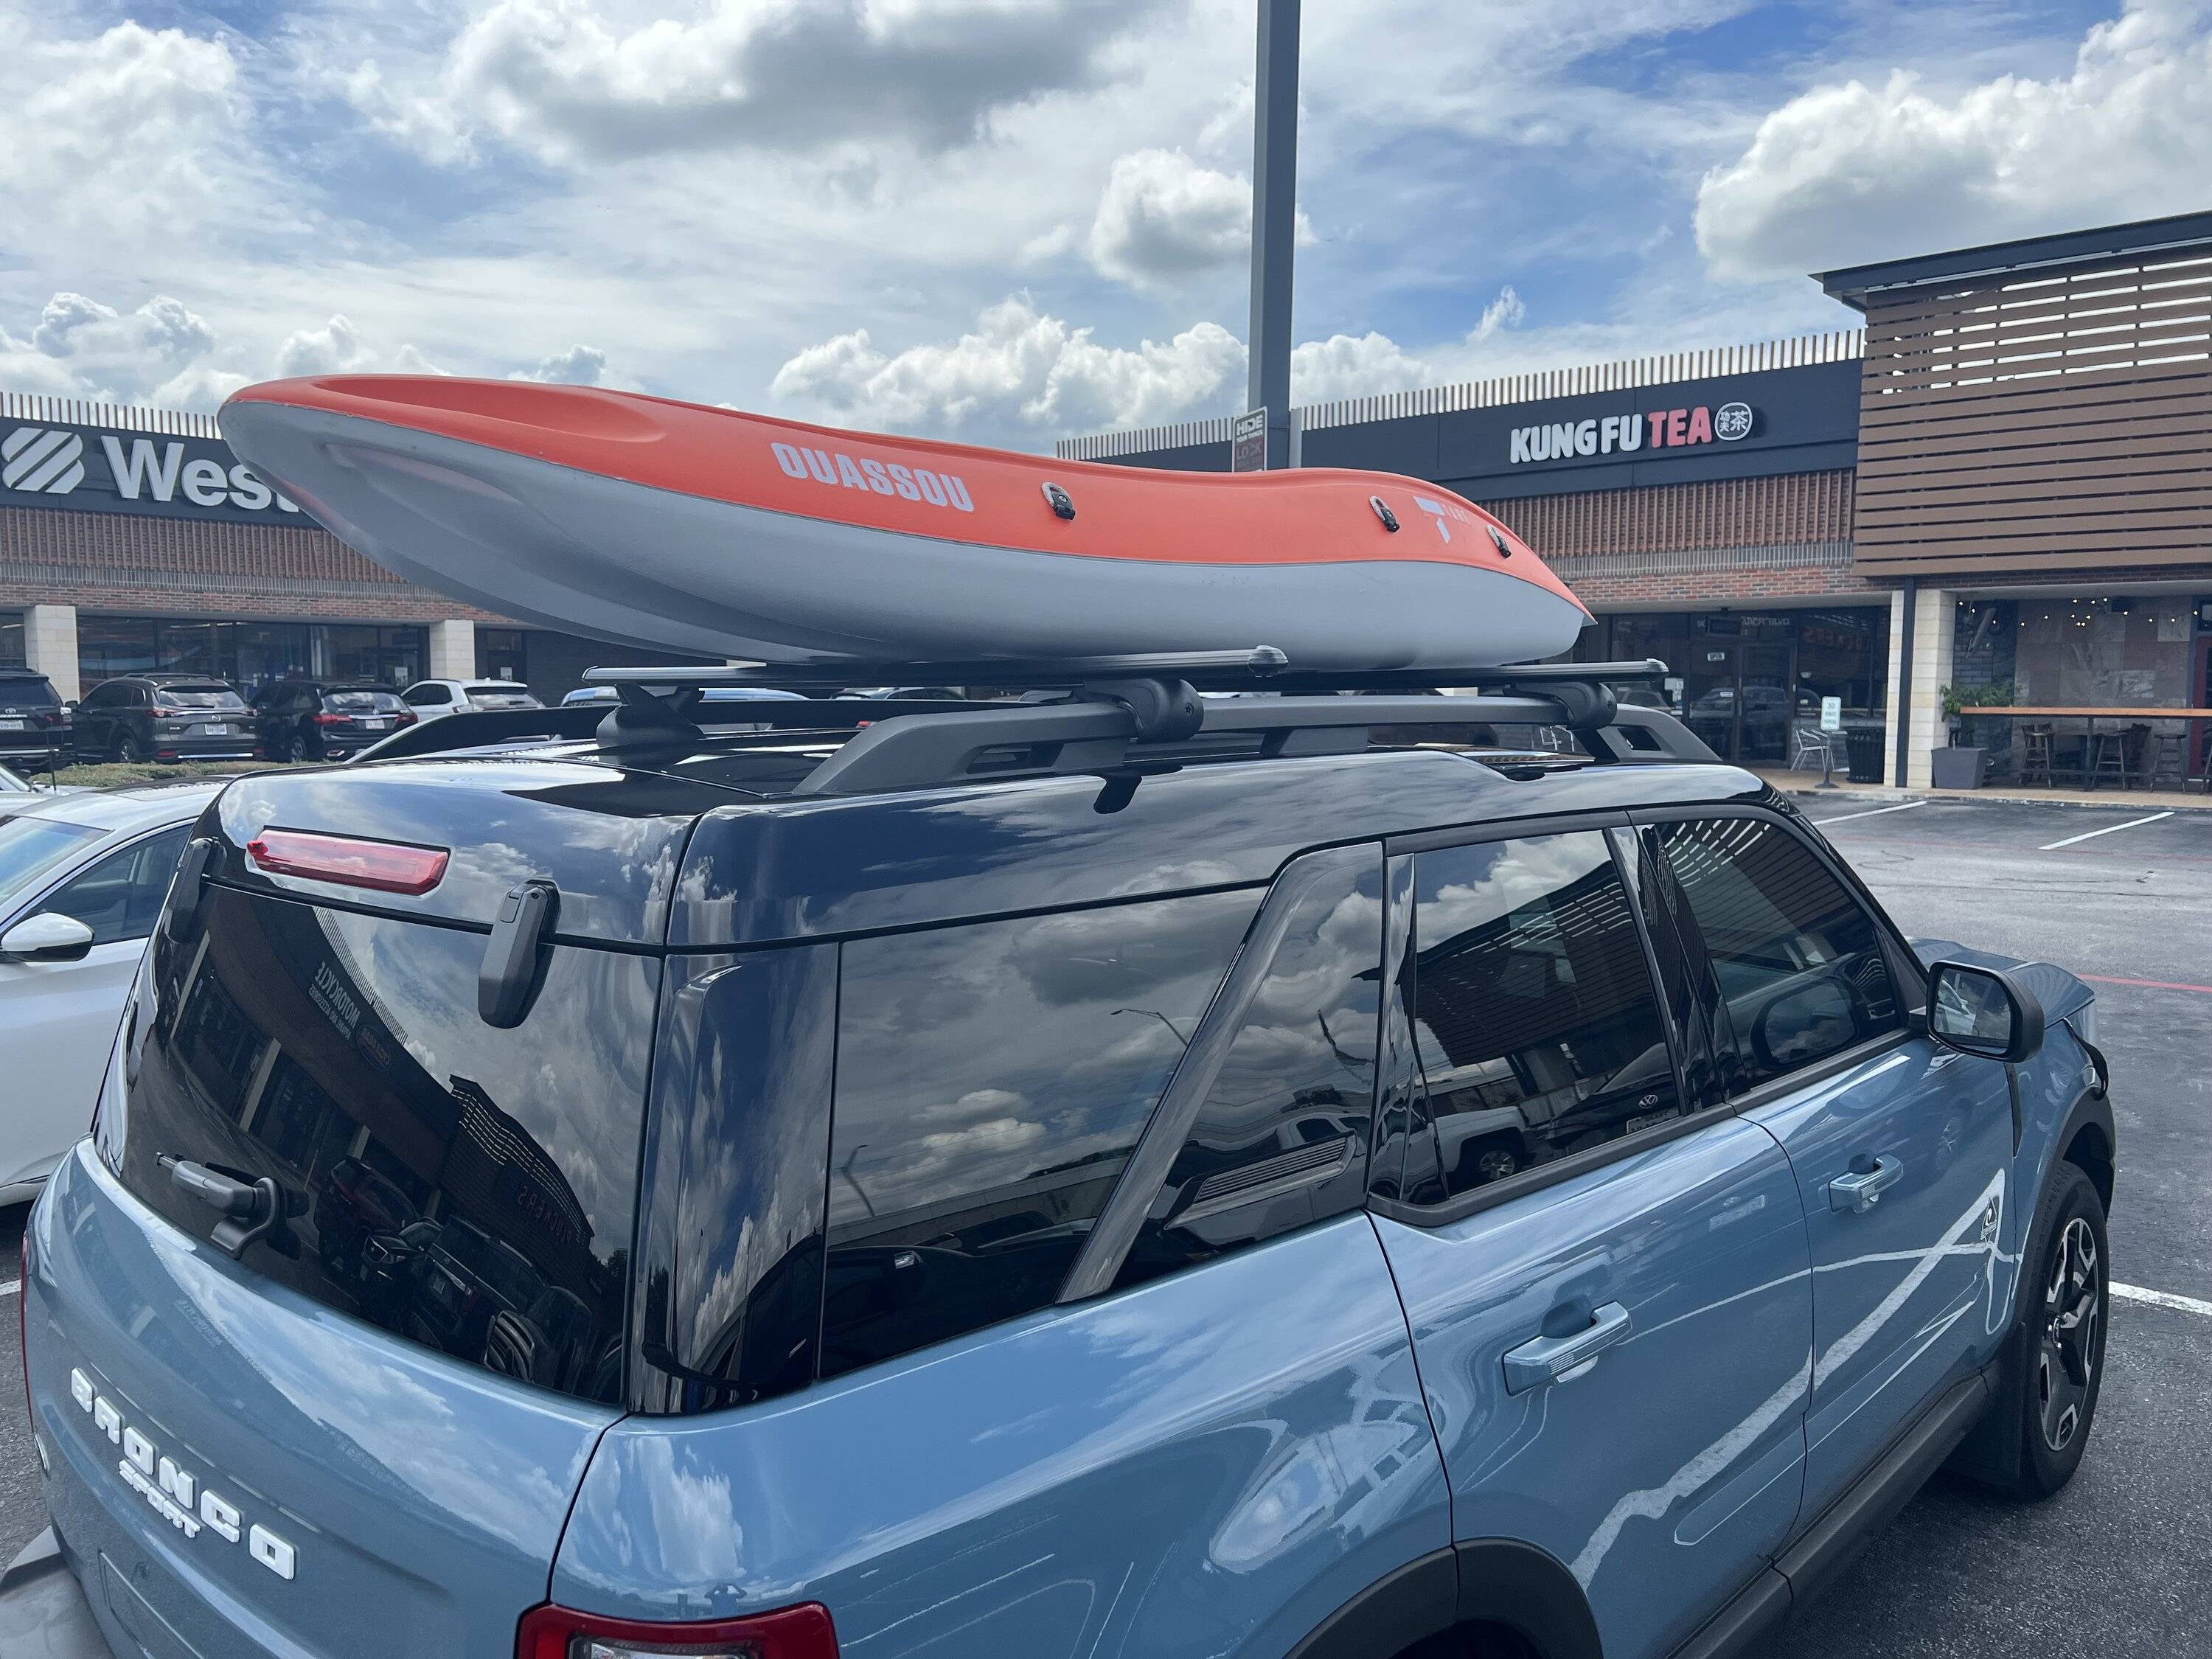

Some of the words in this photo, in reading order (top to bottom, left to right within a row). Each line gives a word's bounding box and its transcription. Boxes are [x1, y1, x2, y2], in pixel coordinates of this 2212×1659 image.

[1510, 419, 1598, 464] KUNG
[1601, 414, 1642, 454] FU
[1648, 406, 1712, 448] TEA
[771, 442, 974, 512] OUASSOU
[71, 1368, 295, 1580] BRONCO
[119, 1459, 201, 1539] SPORT
